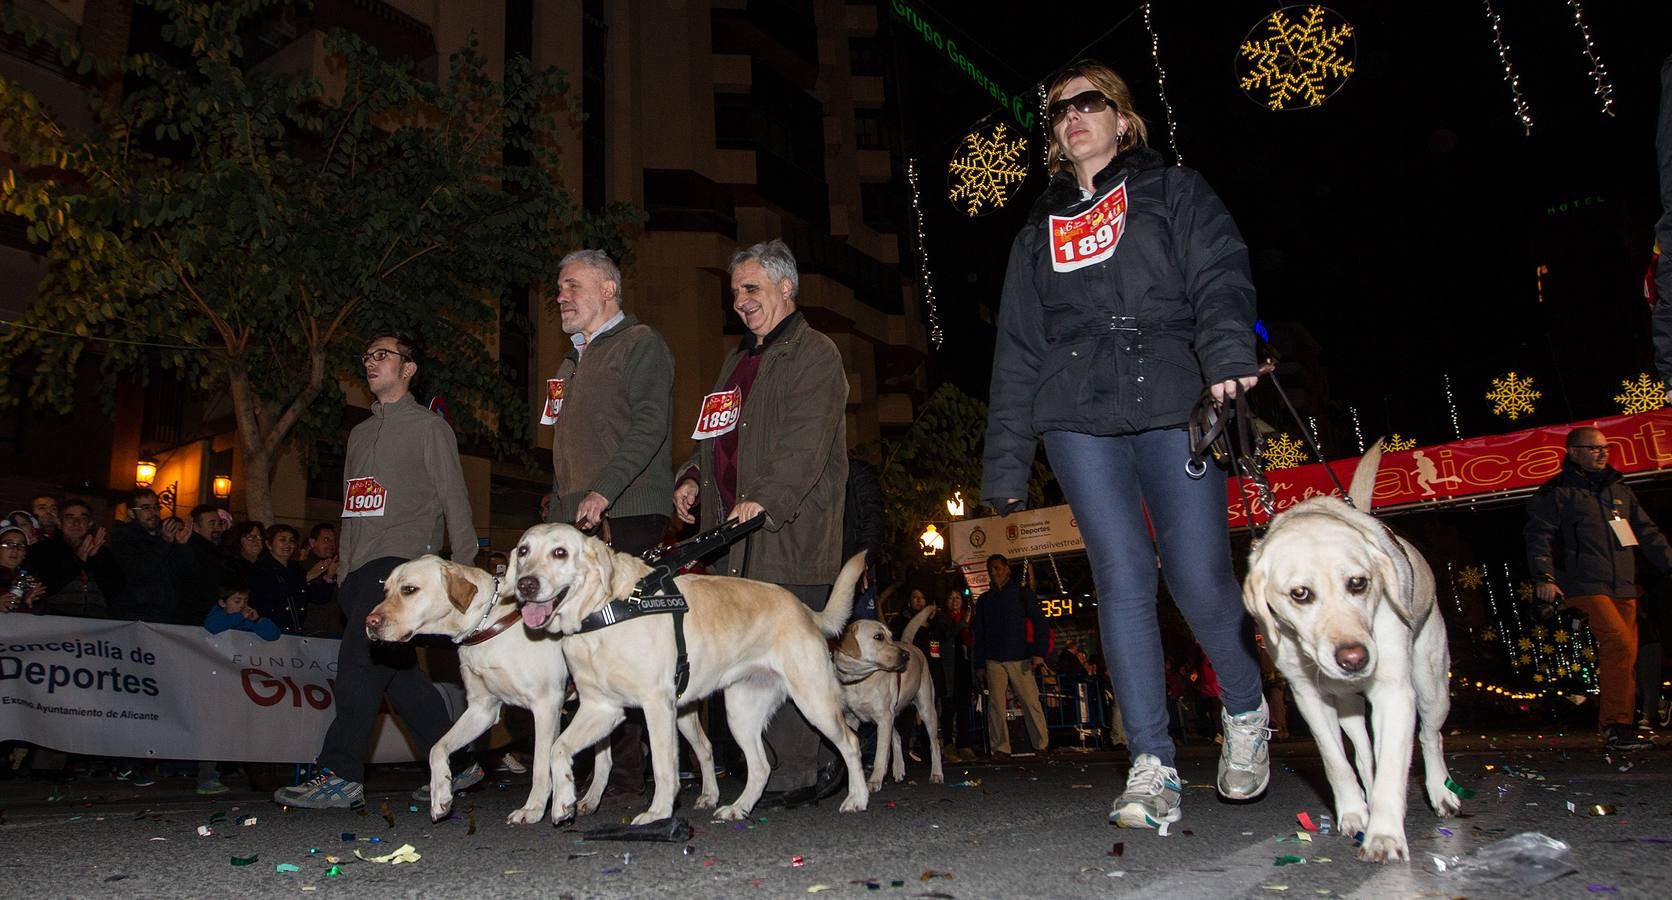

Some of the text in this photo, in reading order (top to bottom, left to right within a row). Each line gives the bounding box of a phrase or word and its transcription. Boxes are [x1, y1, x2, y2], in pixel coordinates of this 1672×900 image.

[891, 0, 1009, 108] Grupo Generala
[1059, 212, 1124, 261] 1897
[702, 407, 738, 431] 1899
[349, 494, 383, 510] 1900
[641, 597, 685, 609] GUIDE DOG
[130, 648, 155, 666] de
[0, 656, 159, 697] Deportes
[36, 703, 103, 717] Ayuntamiento
[106, 709, 118, 719] de
[119, 710, 159, 721] Alicante
